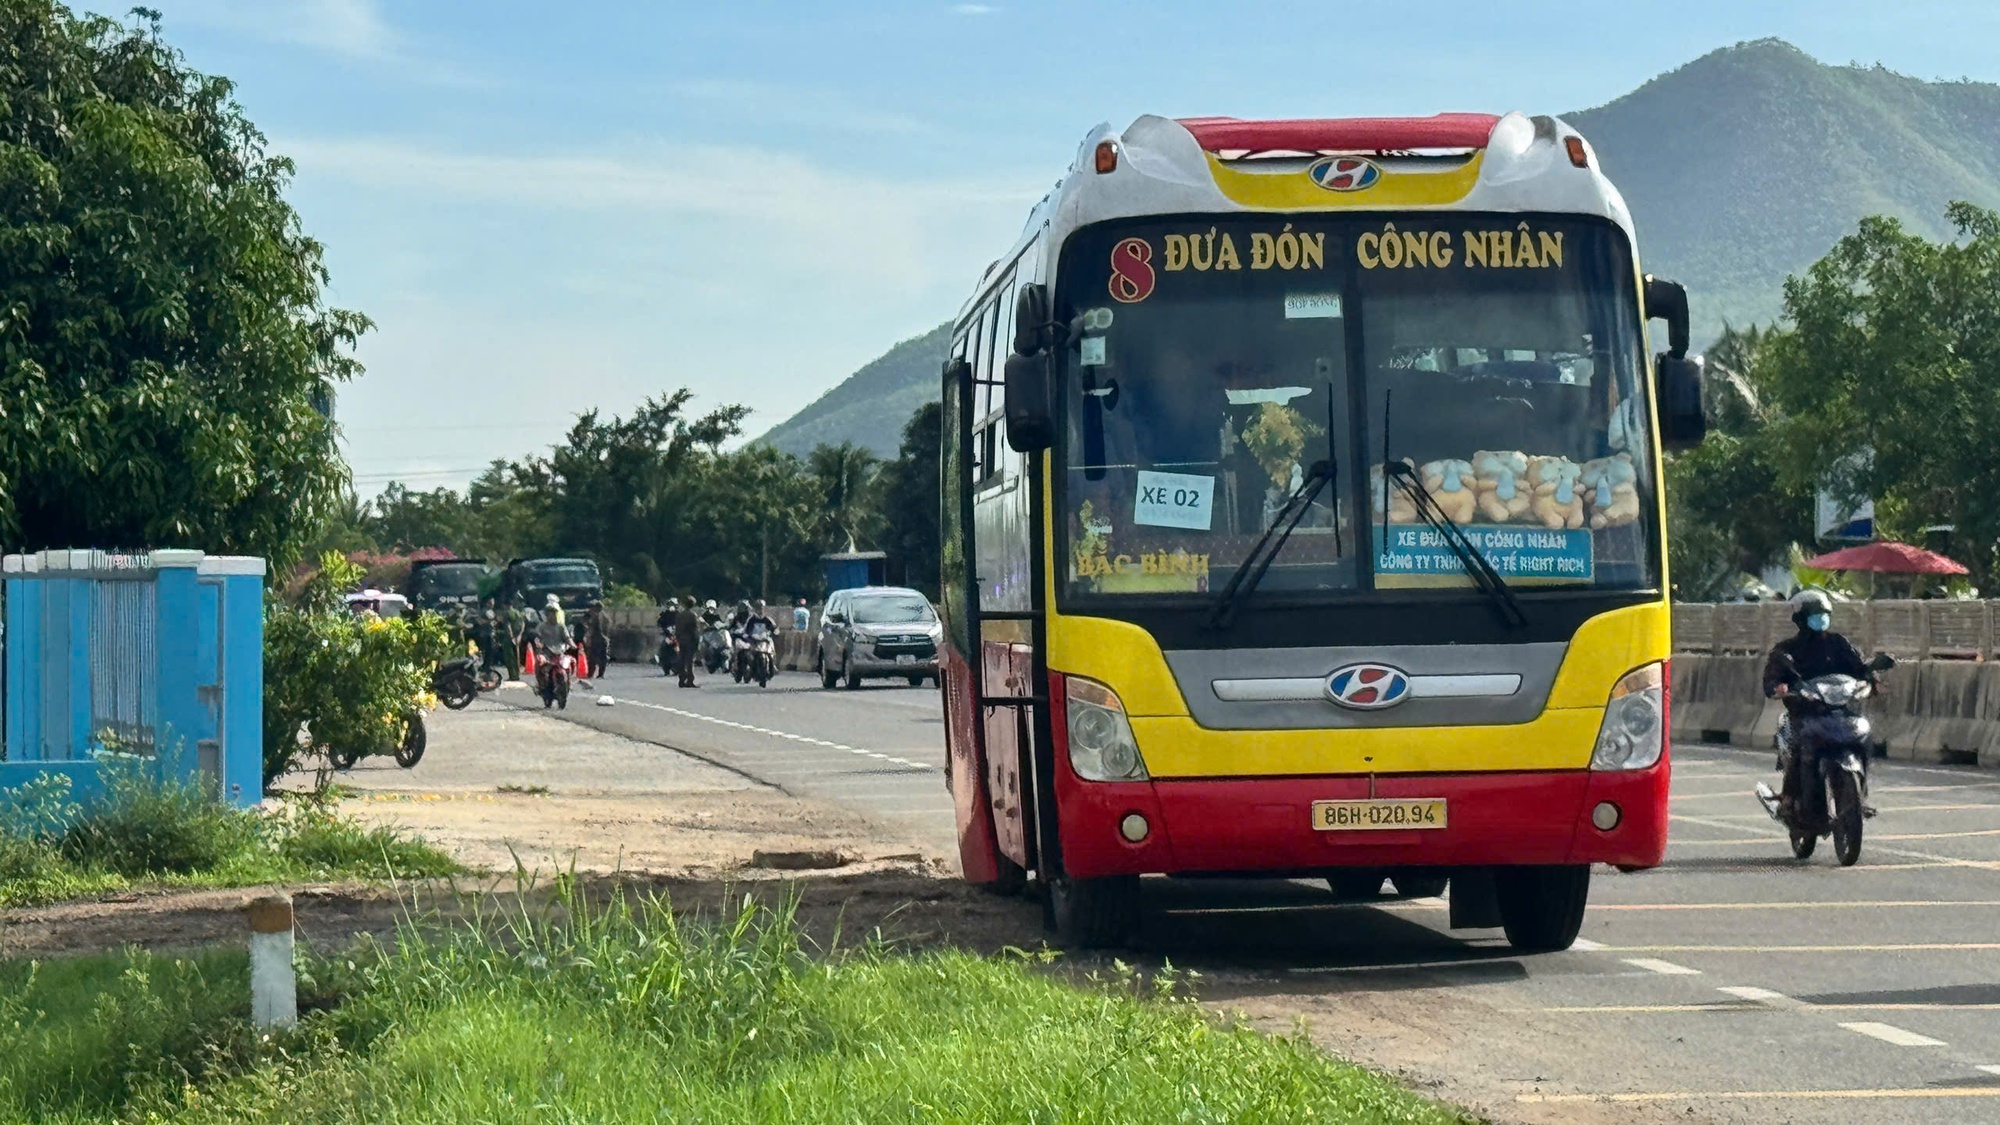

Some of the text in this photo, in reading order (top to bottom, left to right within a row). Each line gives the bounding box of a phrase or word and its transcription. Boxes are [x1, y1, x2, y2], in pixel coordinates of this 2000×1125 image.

[1164, 221, 1564, 271] ĐƯA ĐÓN CÔNG NHÂN
[1108, 237, 1156, 303] 8
[1141, 486, 1200, 508] XE 02
[1397, 531, 1417, 547] XE
[1415, 554, 1430, 569] TY
